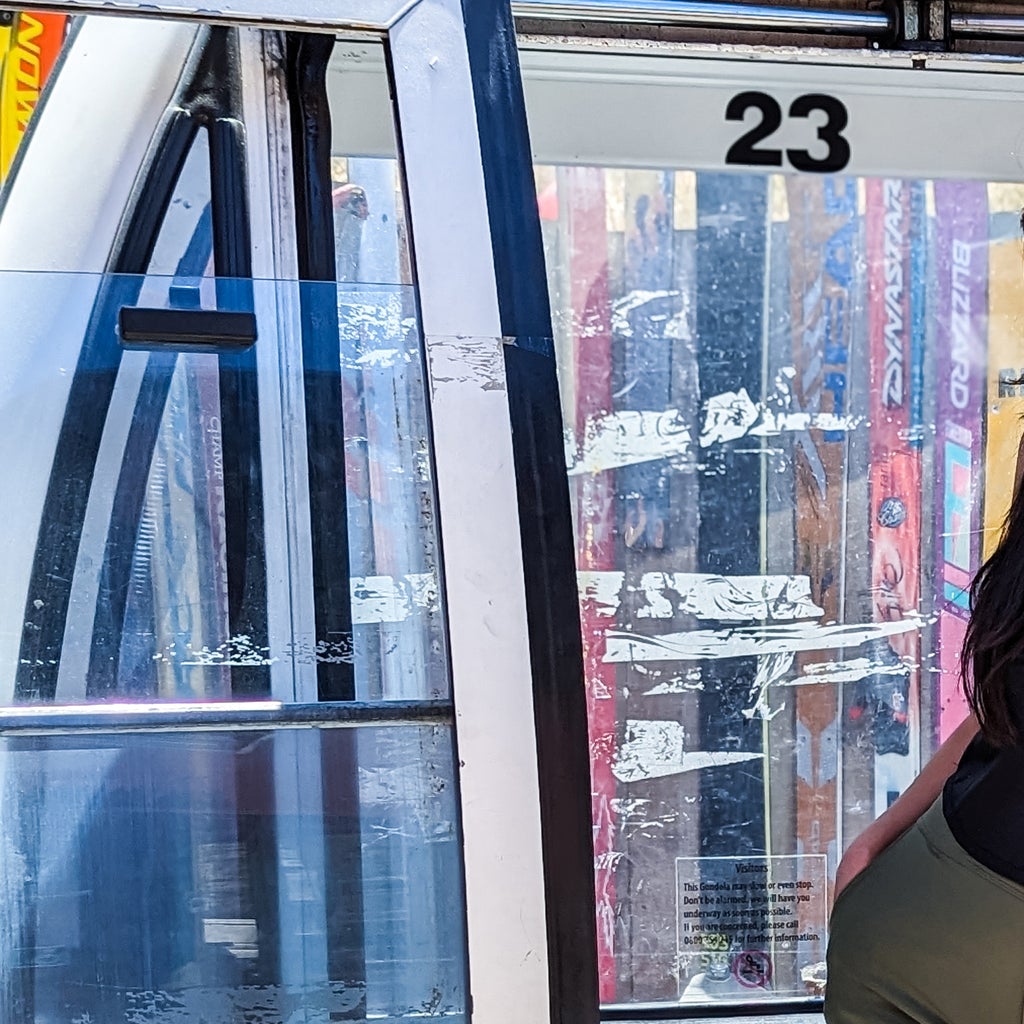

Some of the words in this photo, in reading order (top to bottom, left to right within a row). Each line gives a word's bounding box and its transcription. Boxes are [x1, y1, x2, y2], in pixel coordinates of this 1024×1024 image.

[725, 91, 851, 174] 23
[882, 178, 903, 407] DYNASTAR
[950, 238, 972, 409] BLIZZARD
[735, 863, 769, 874] Visitors
[683, 882, 698, 892] This
[700, 881, 730, 892] Gondola
[732, 884, 747, 893] may
[777, 882, 795, 890] even
[795, 881, 814, 891] stop.
[683, 896, 703, 905] Don't
[704, 895, 714, 905] be
[777, 893, 795, 902] have
[796, 894, 811, 904] you
[683, 909, 721, 919] underway
[731, 909, 749, 917] soon
[760, 907, 793, 918] possible.
[691, 923, 705, 933] you
[705, 923, 718, 931] are
[760, 920, 785, 931] please
[786, 919, 799, 928] call
[746, 934, 773, 943] further
[774, 932, 821, 942] information.
